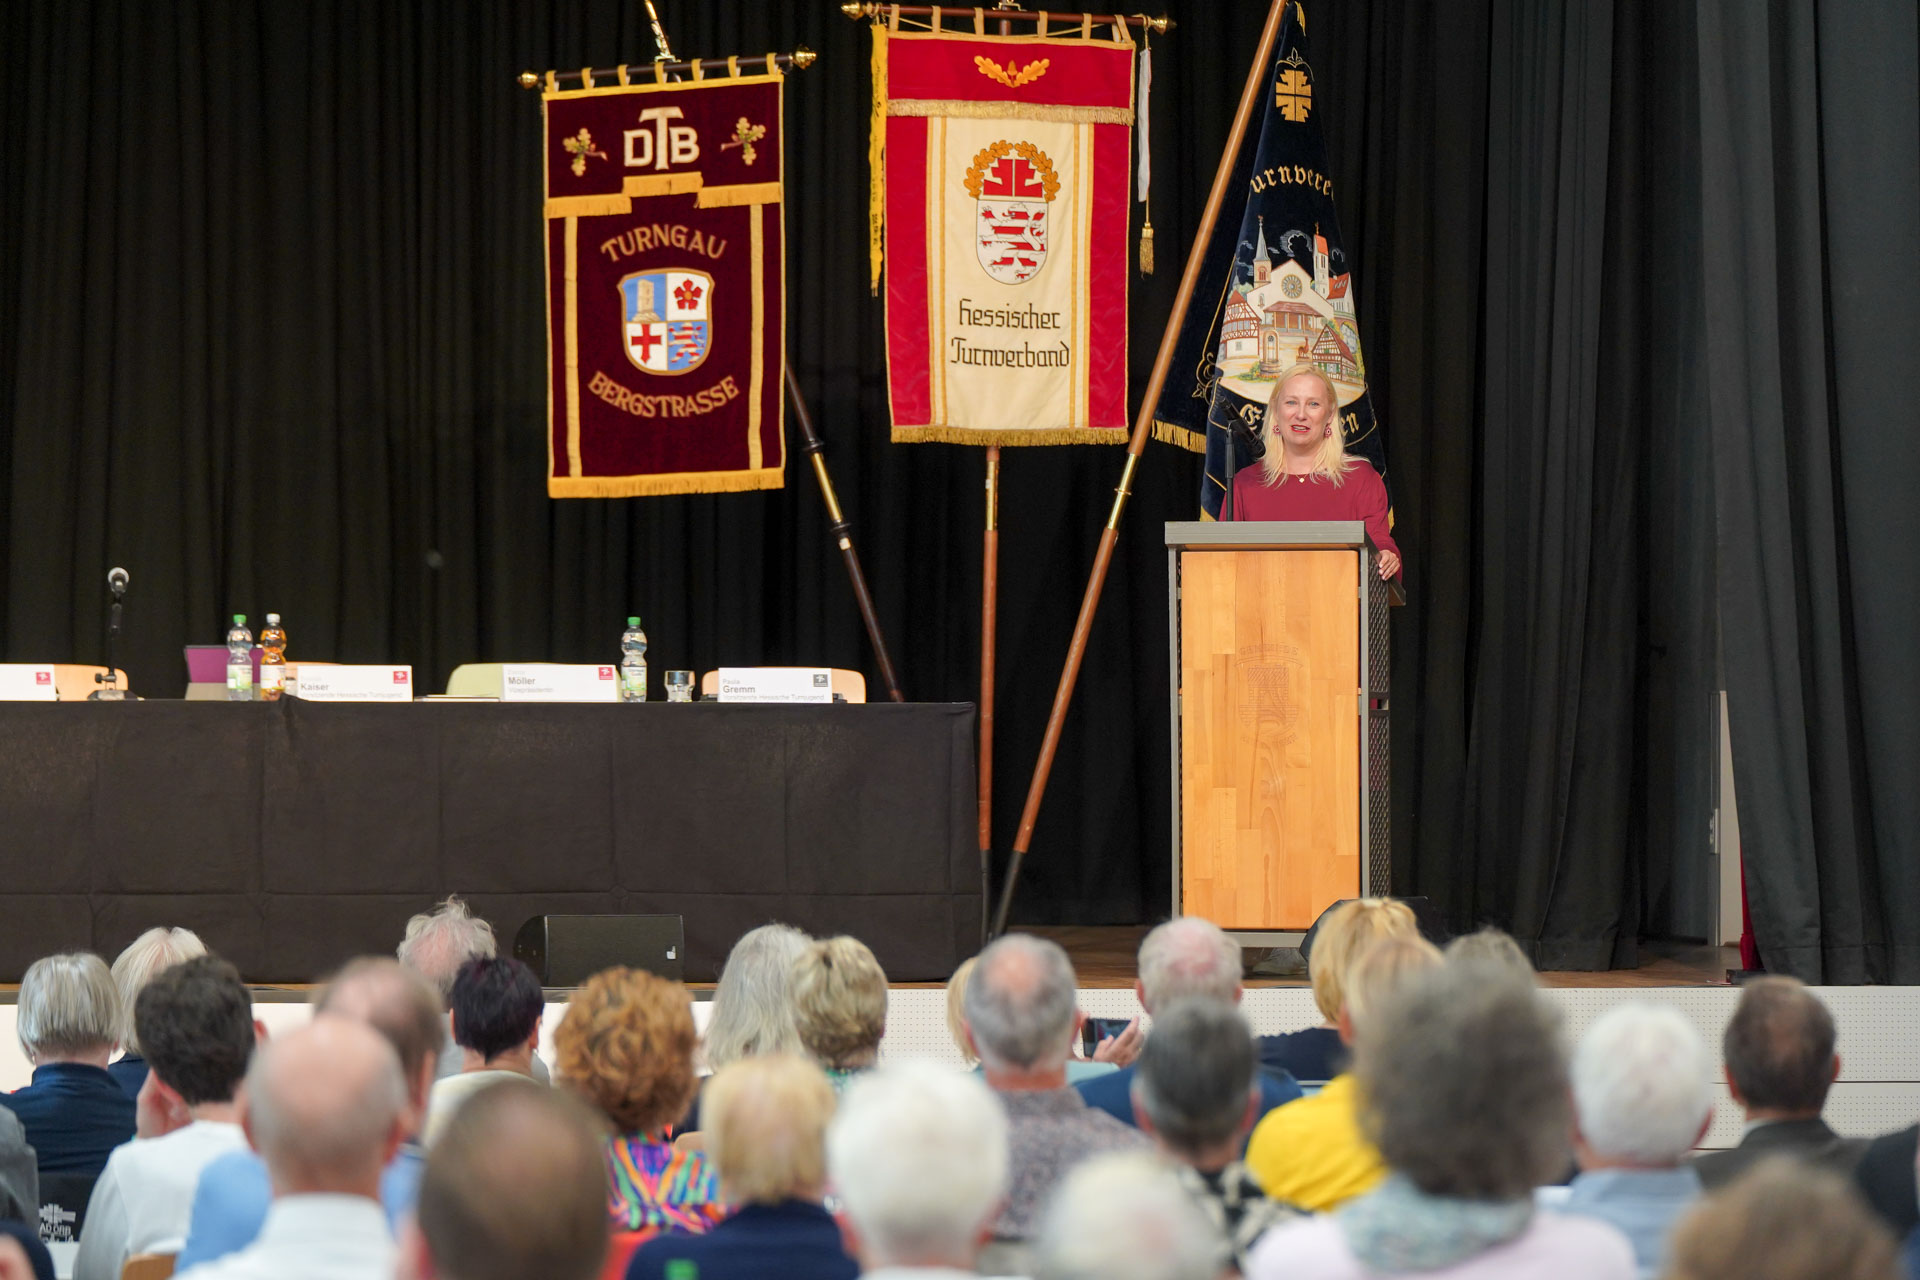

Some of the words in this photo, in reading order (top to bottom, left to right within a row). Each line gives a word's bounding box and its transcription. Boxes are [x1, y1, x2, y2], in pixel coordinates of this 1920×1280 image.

[623, 106, 700, 170] DTB
[1250, 164, 1334, 200] urnvere
[600, 224, 727, 262] TURNGAU
[950, 336, 1070, 368] Turnverband
[587, 370, 740, 418] BERGSTRASSE
[300, 683, 329, 691] Kaiser
[508, 676, 536, 685] Möller
[722, 685, 756, 694] Gremm
